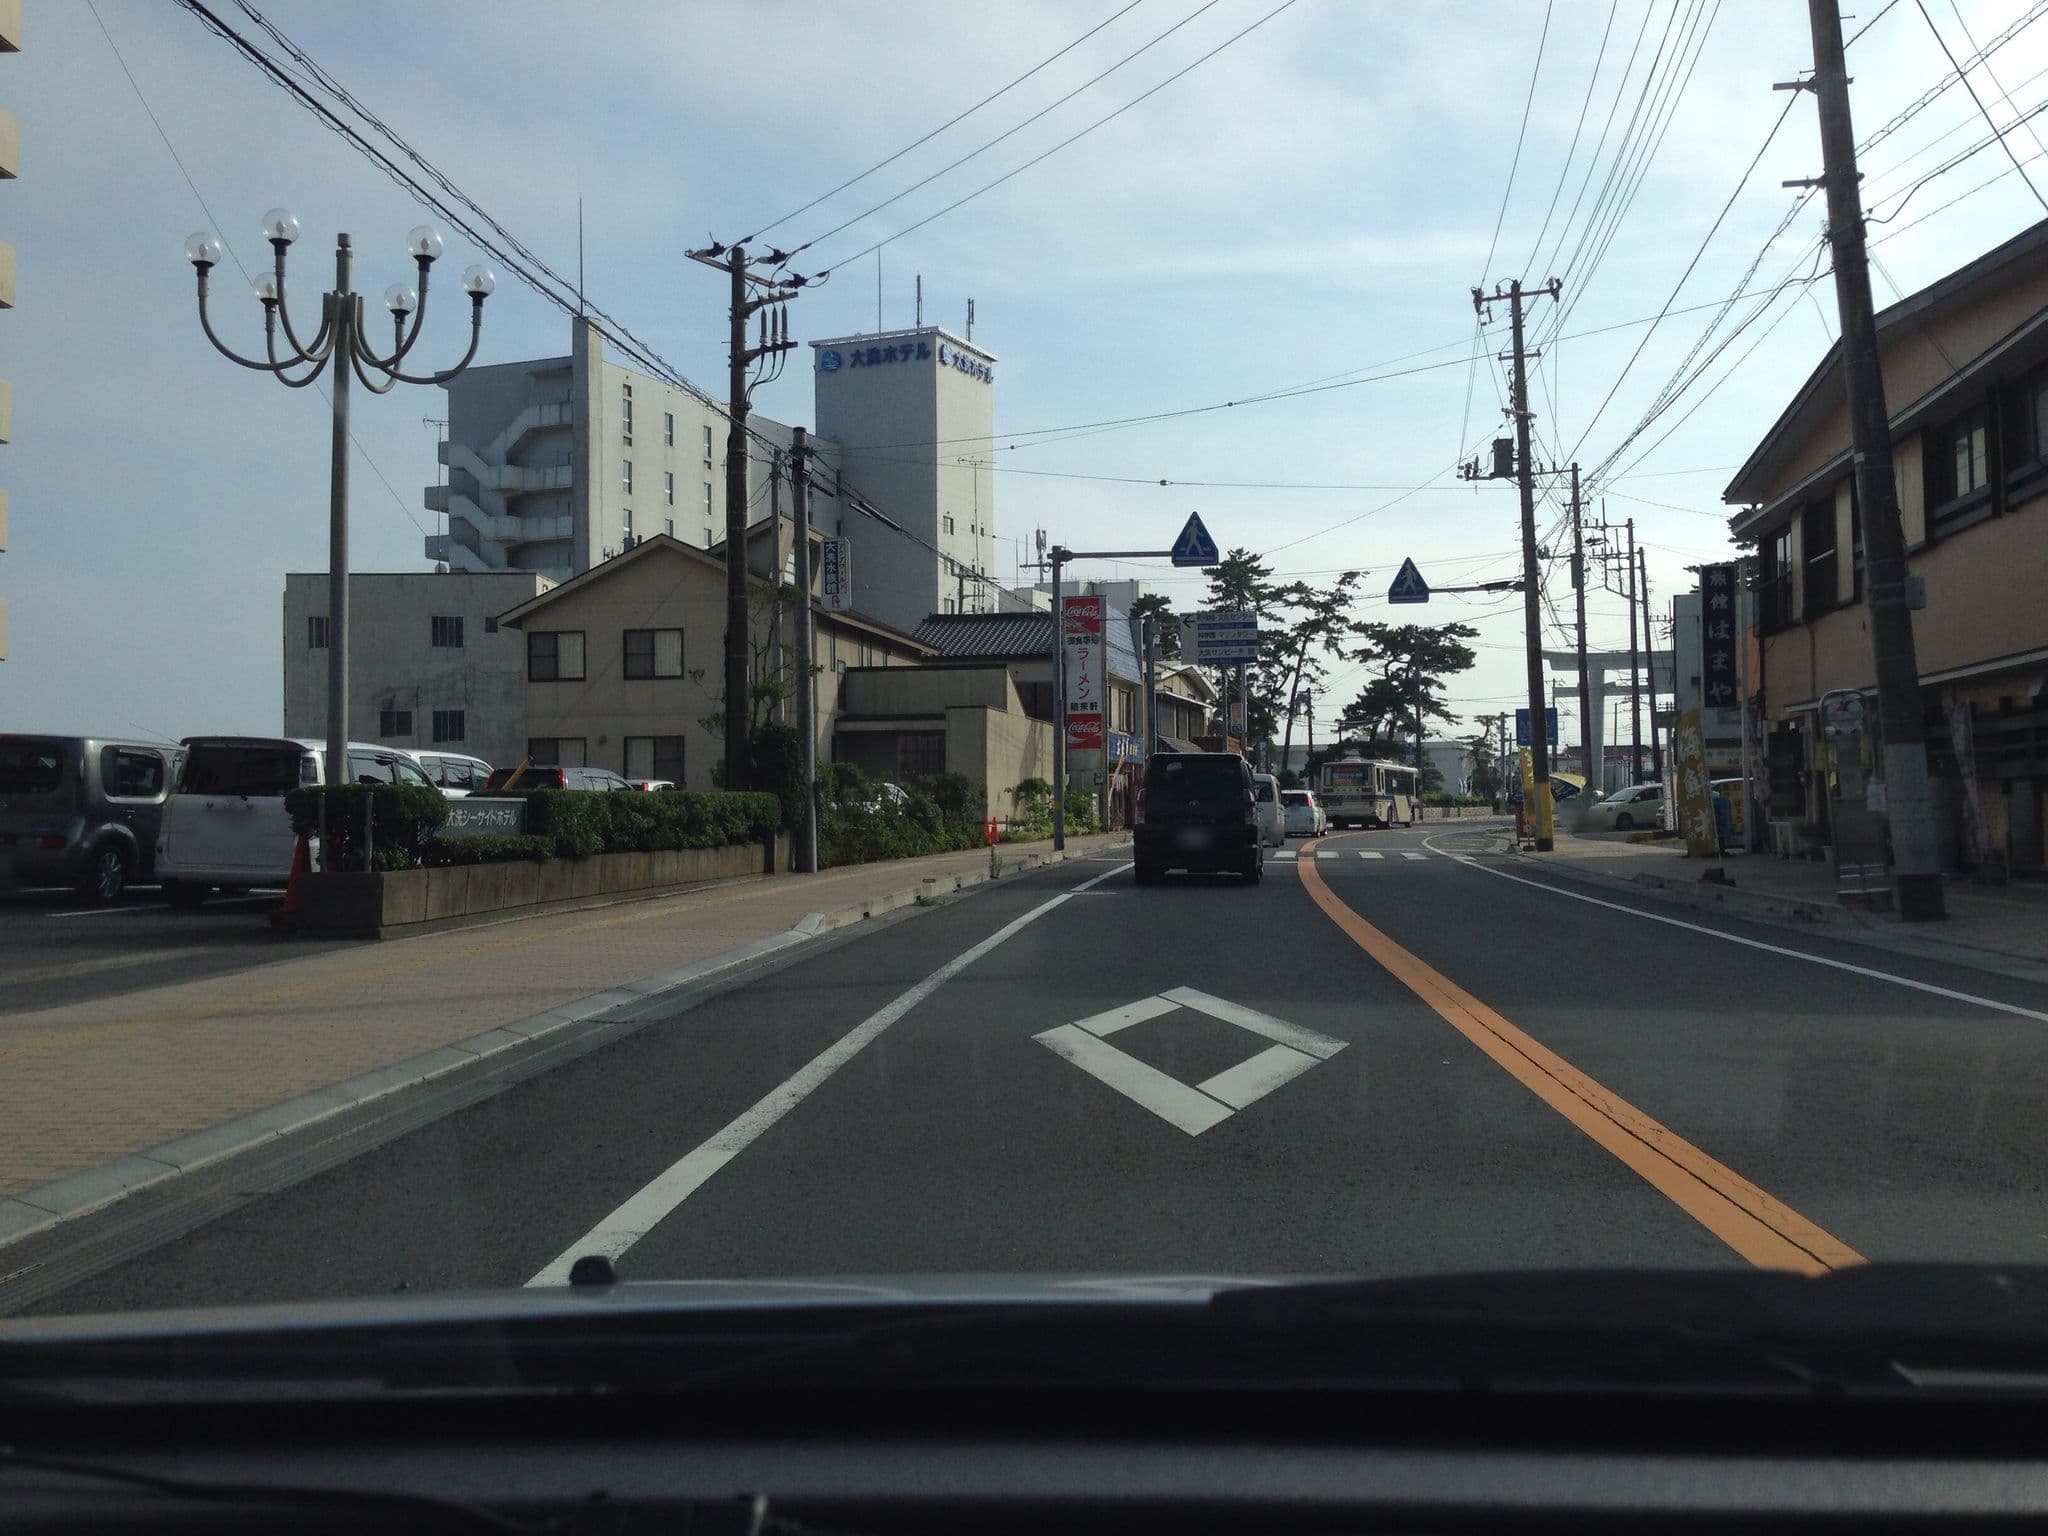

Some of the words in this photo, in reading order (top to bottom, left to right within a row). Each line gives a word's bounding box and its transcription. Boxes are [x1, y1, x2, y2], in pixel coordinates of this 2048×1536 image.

[1077, 647, 1090, 700] ラーメン
[1708, 570, 1732, 704] 旅館はまや
